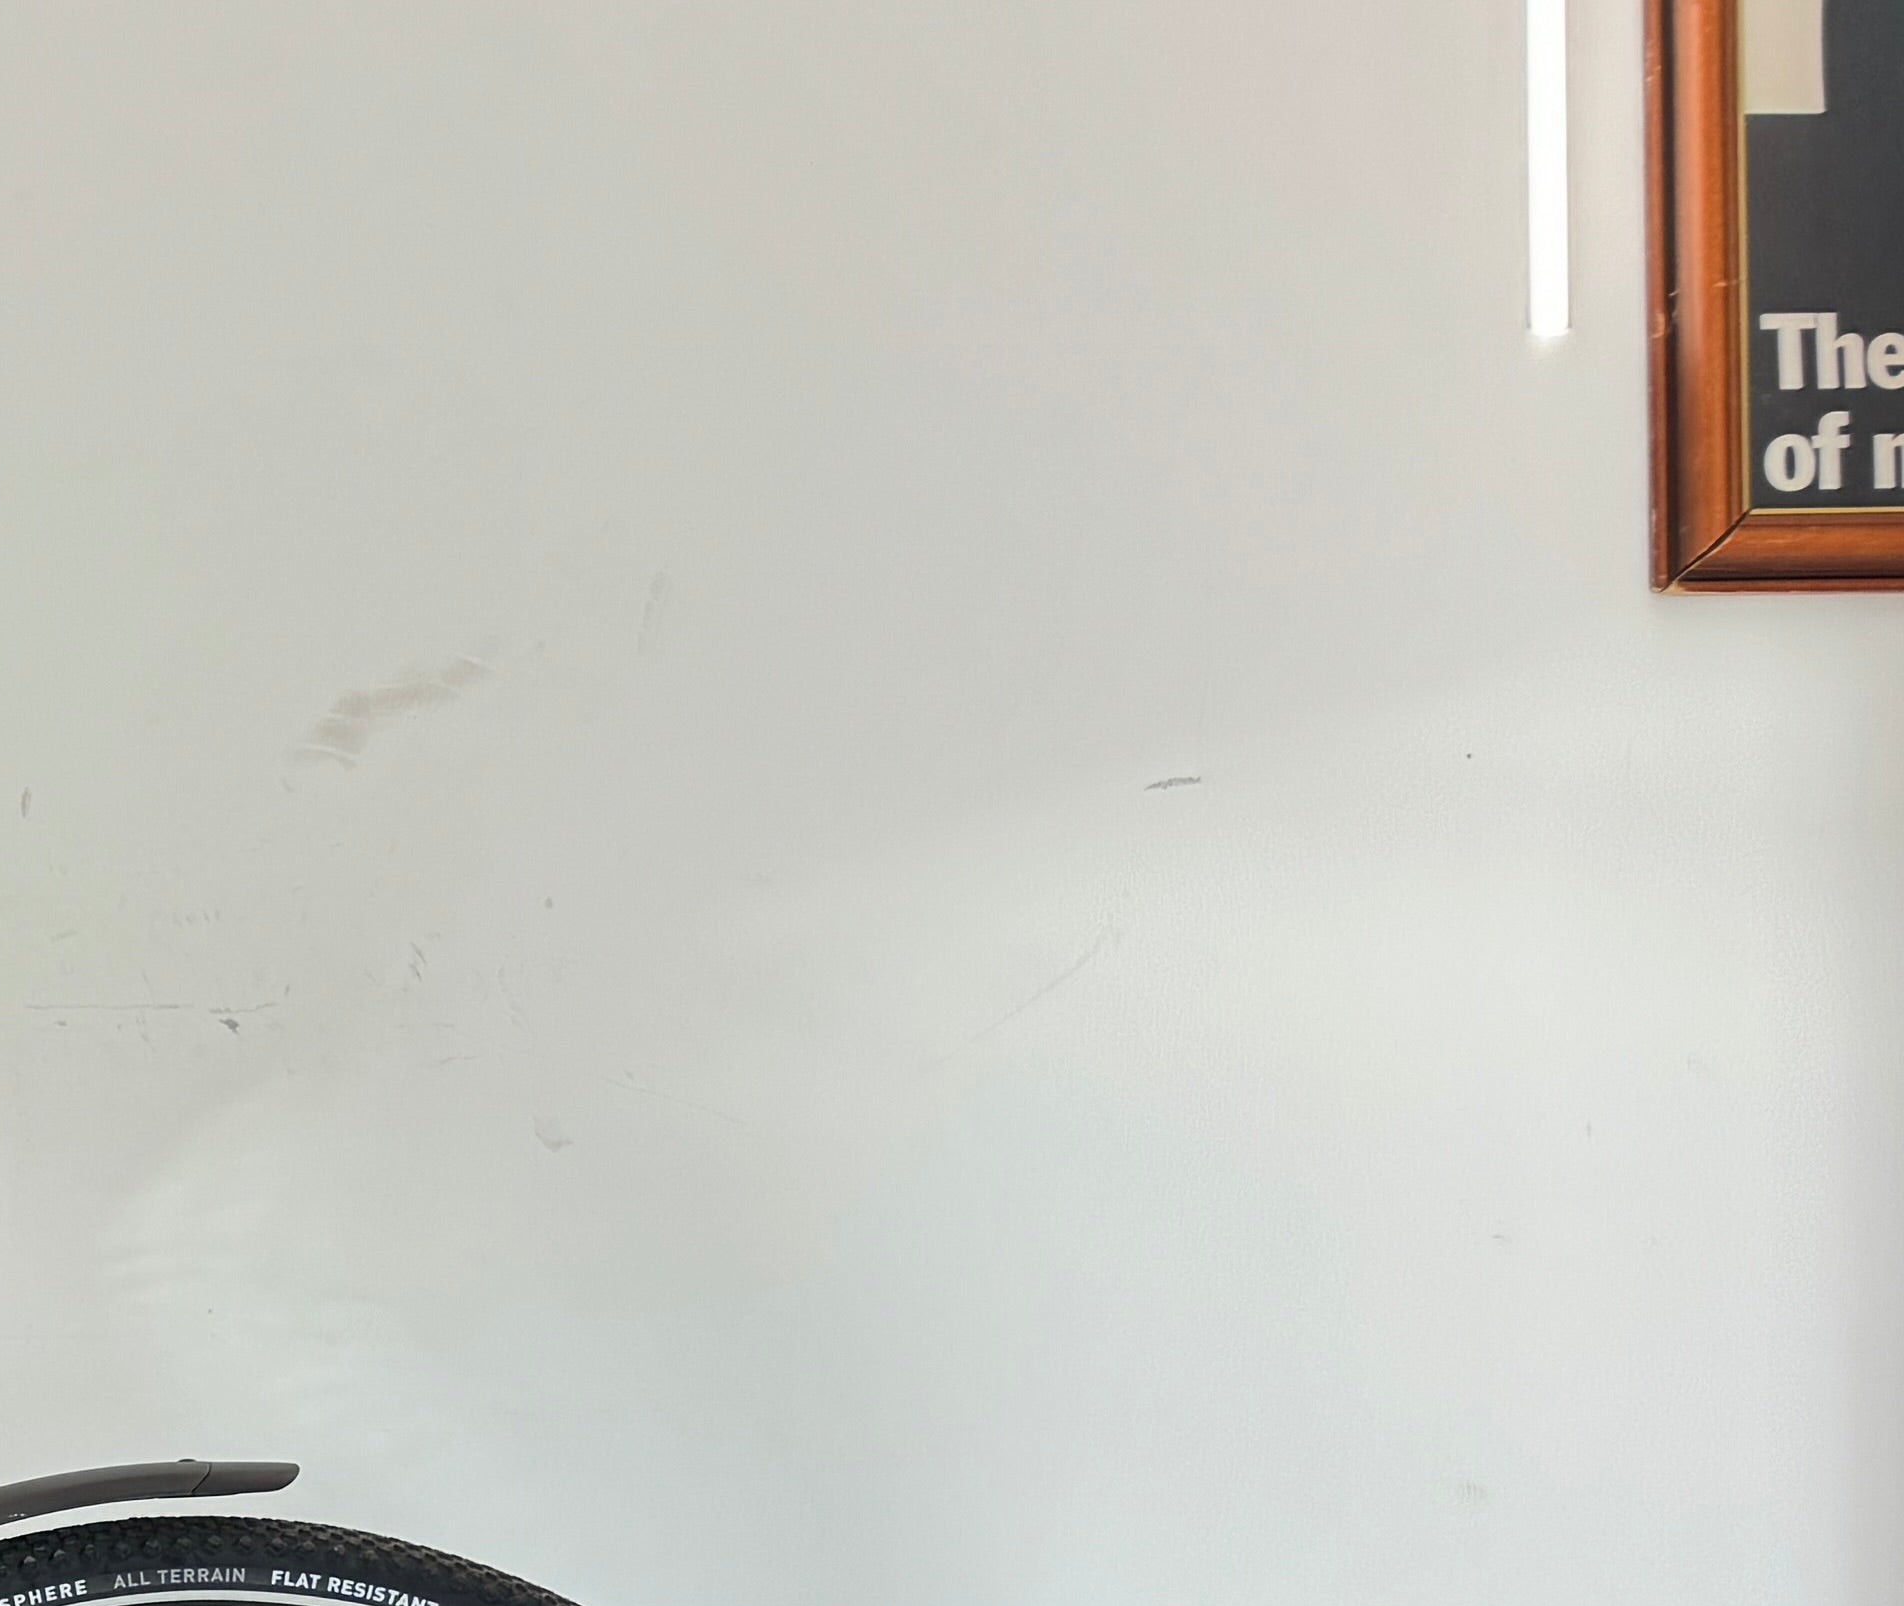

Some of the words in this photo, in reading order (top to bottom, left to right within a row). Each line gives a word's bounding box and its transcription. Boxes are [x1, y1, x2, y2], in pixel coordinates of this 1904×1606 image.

[1759, 312, 1904, 390] The
[1763, 410, 1851, 492] of
[113, 1571, 152, 1590] ALL
[156, 1567, 246, 1586] TERRAIN
[270, 1569, 322, 1590] FLAT
